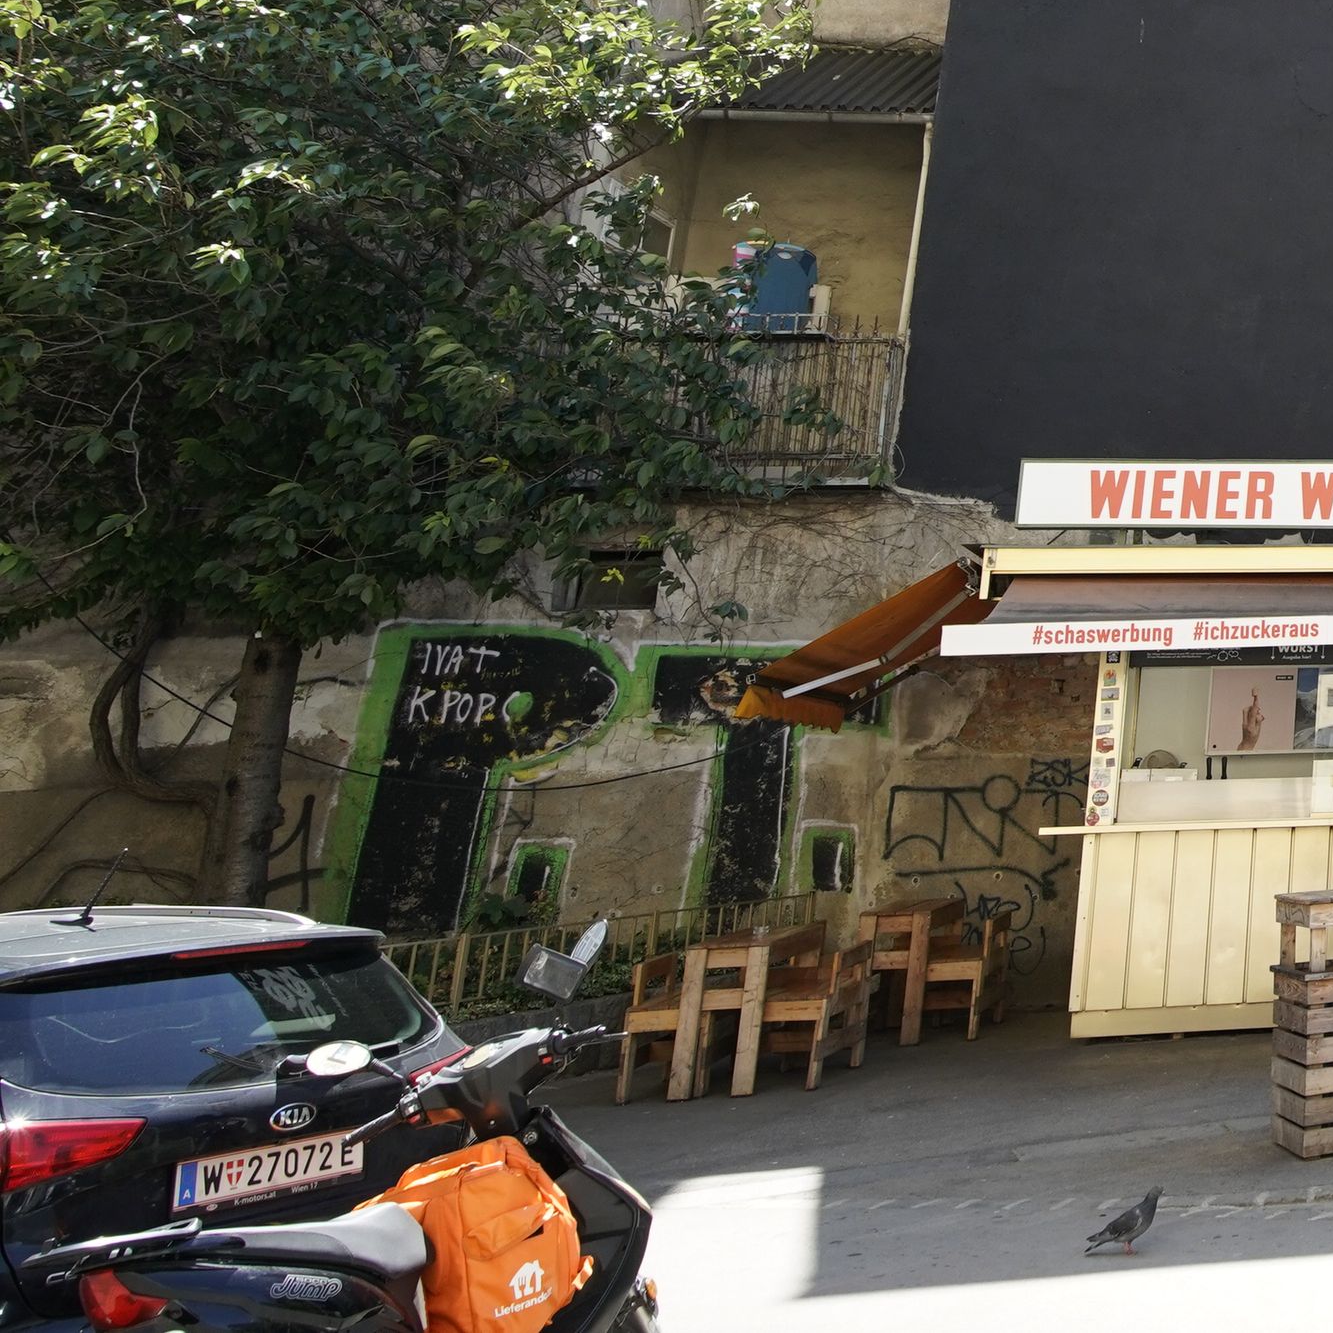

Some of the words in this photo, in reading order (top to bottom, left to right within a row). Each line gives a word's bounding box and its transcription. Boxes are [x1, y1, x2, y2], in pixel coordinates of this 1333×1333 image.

[1090, 470, 1274, 519] WIENER
[1033, 625, 1174, 647] #schaswerbung
[1193, 620, 1319, 641] #ichzuckeraus
[278, 1106, 312, 1127] KIA
[183, 1189, 191, 1200] A
[203, 1162, 224, 1196] W
[234, 1191, 278, 1207] K-motors.at
[291, 1183, 308, 1195] Wien
[309, 1181, 318, 1191] 17
